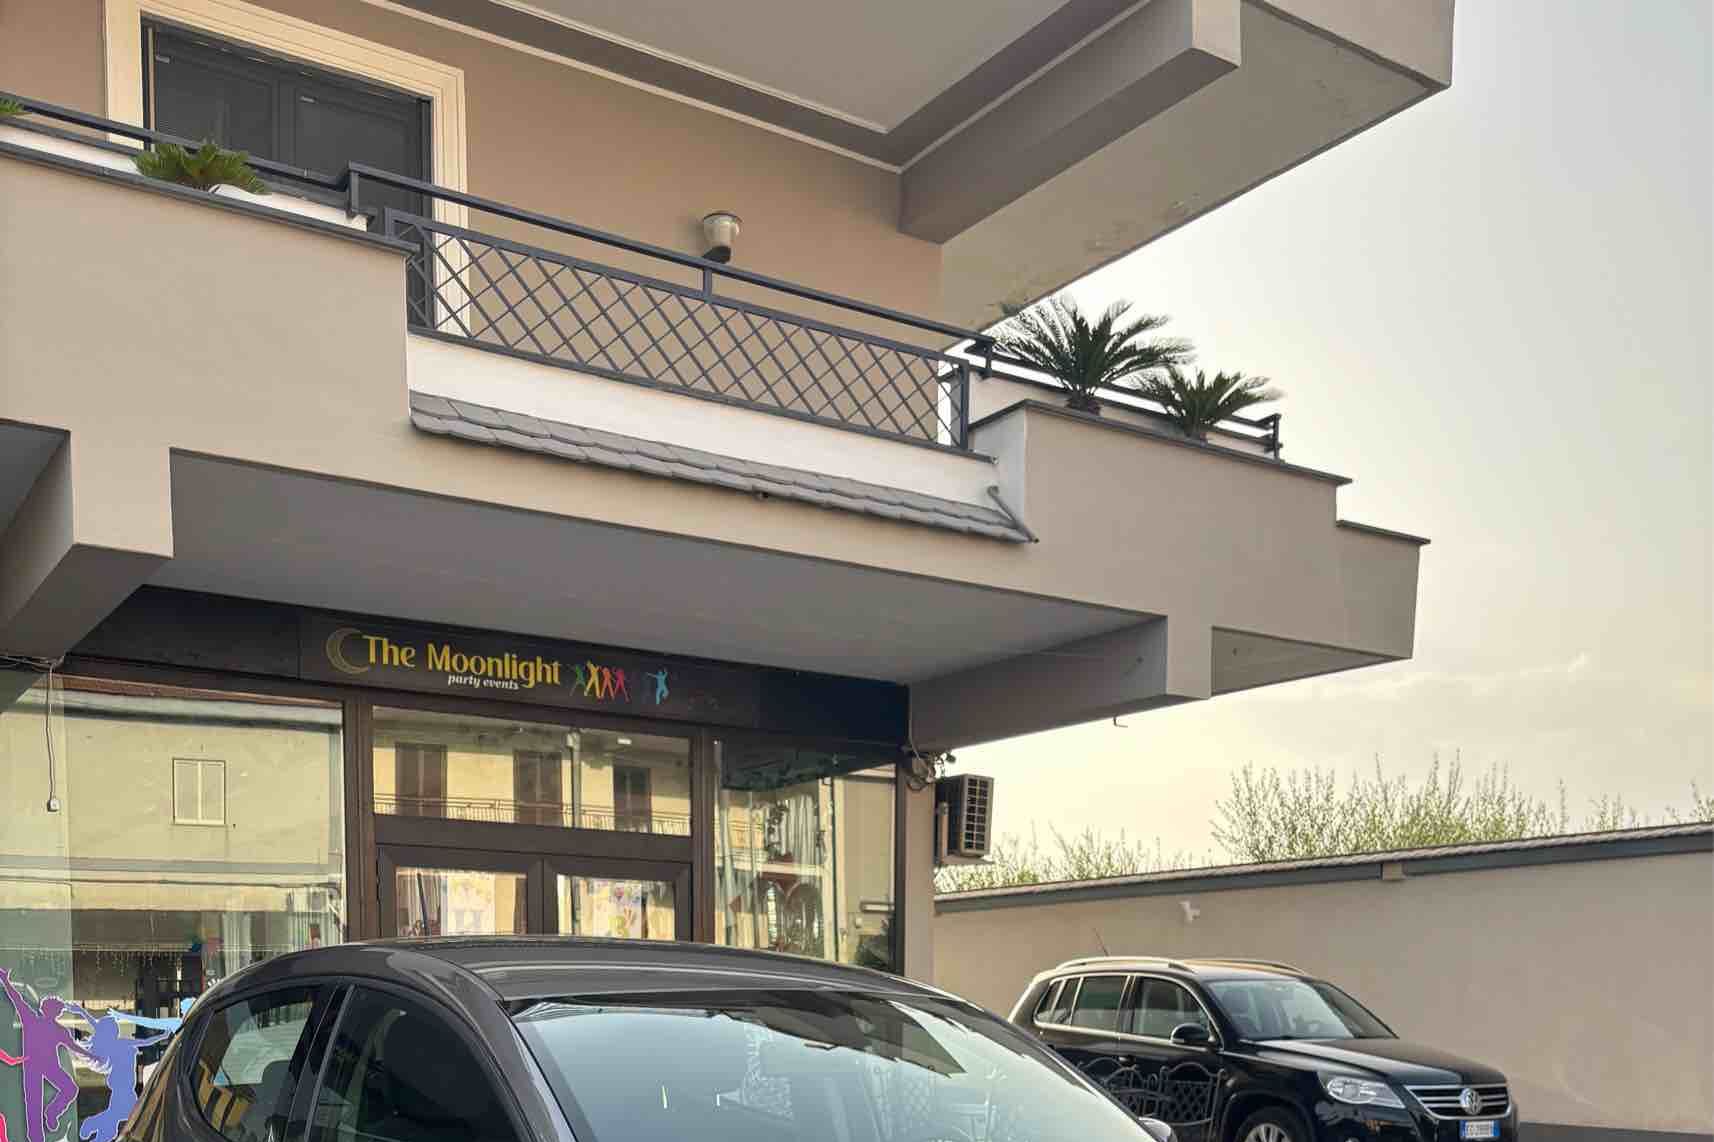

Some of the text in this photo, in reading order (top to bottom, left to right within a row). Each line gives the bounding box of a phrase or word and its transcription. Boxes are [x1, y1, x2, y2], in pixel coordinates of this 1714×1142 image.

[363, 634, 561, 688] The Moonlight
[447, 674, 519, 690] party events
